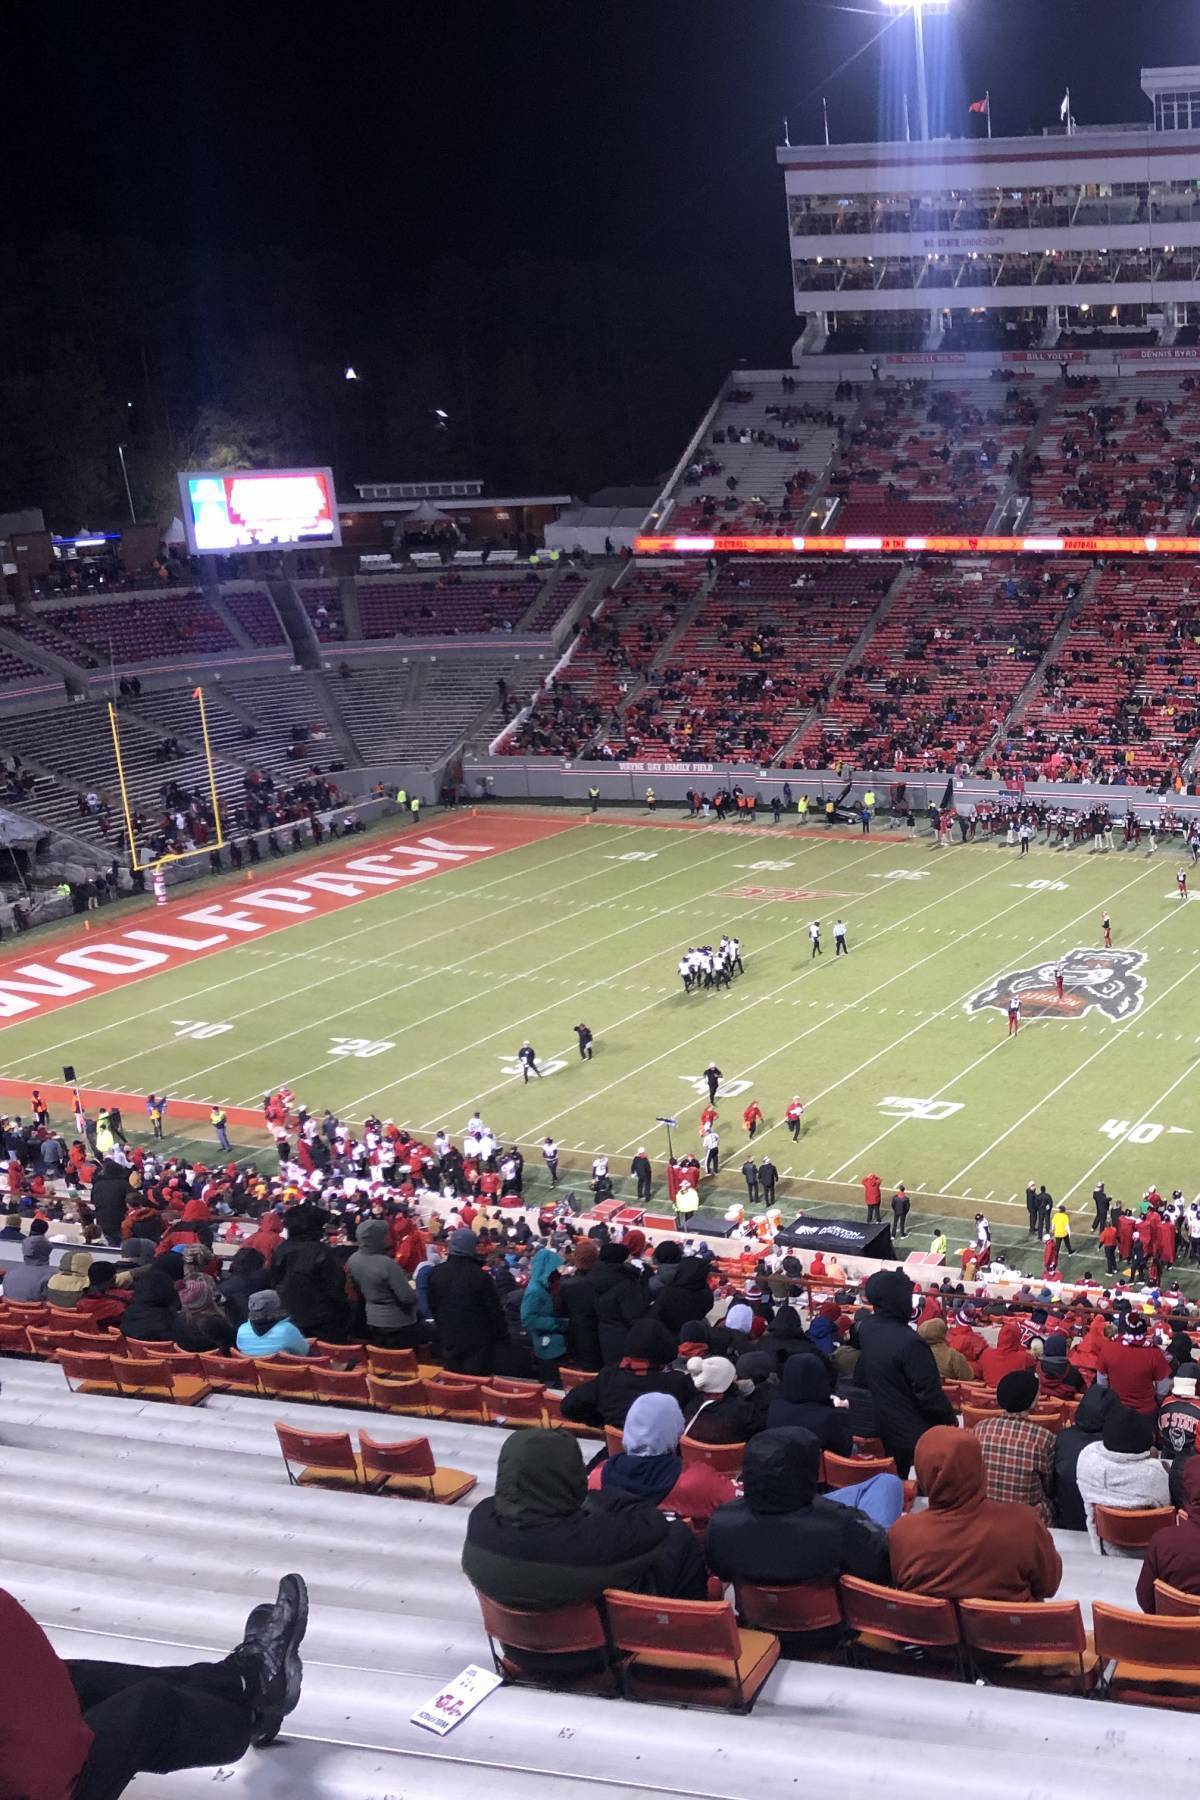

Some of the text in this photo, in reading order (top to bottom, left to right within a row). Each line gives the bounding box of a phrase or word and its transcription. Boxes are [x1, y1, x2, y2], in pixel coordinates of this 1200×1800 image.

[1026, 353, 1045, 361] BILL
[1141, 349, 1198, 359] DENNIS BYRD
[1064, 540, 1098, 549] FOOTBALL
[618, 762, 644, 771] WAYNE
[664, 763, 691, 772] FAMILY
[693, 763, 714, 772] FIELD
[1024, 879, 1070, 890] 40
[327, 1038, 396, 1058] 20
[1098, 1118, 1166, 1145] 40
[1170, 1412, 1200, 1433] STAT
